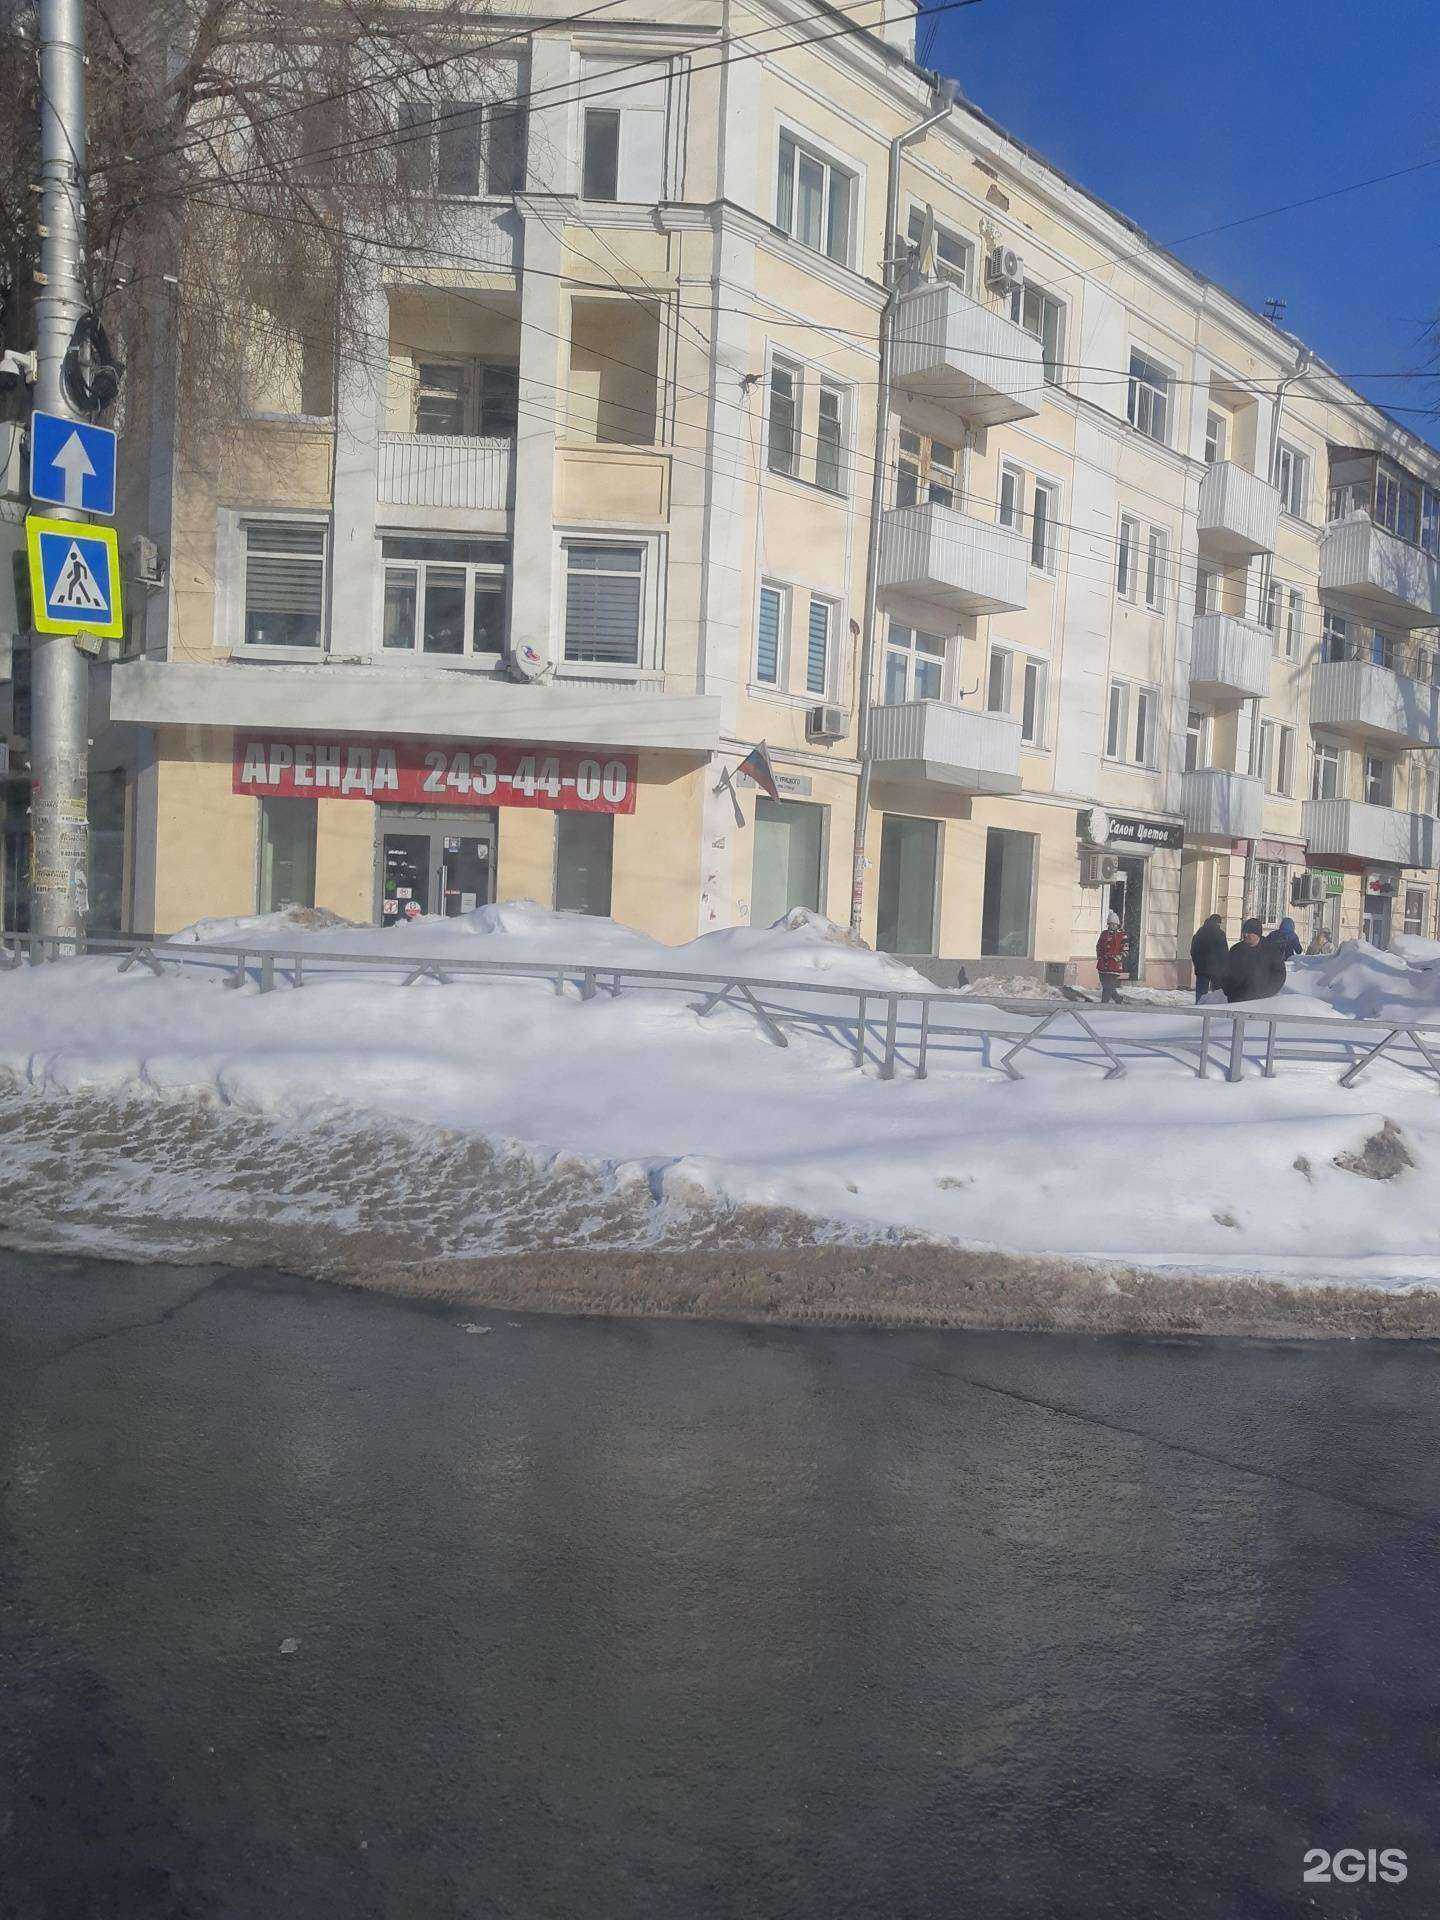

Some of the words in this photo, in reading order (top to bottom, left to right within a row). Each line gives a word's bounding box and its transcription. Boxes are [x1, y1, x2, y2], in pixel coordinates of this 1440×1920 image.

[241, 742, 400, 796] АРЕНДА
[422, 750, 628, 803] 243-44-00
[1109, 819, 1135, 837] Салон
[1137, 823, 1169, 842] Цветов
